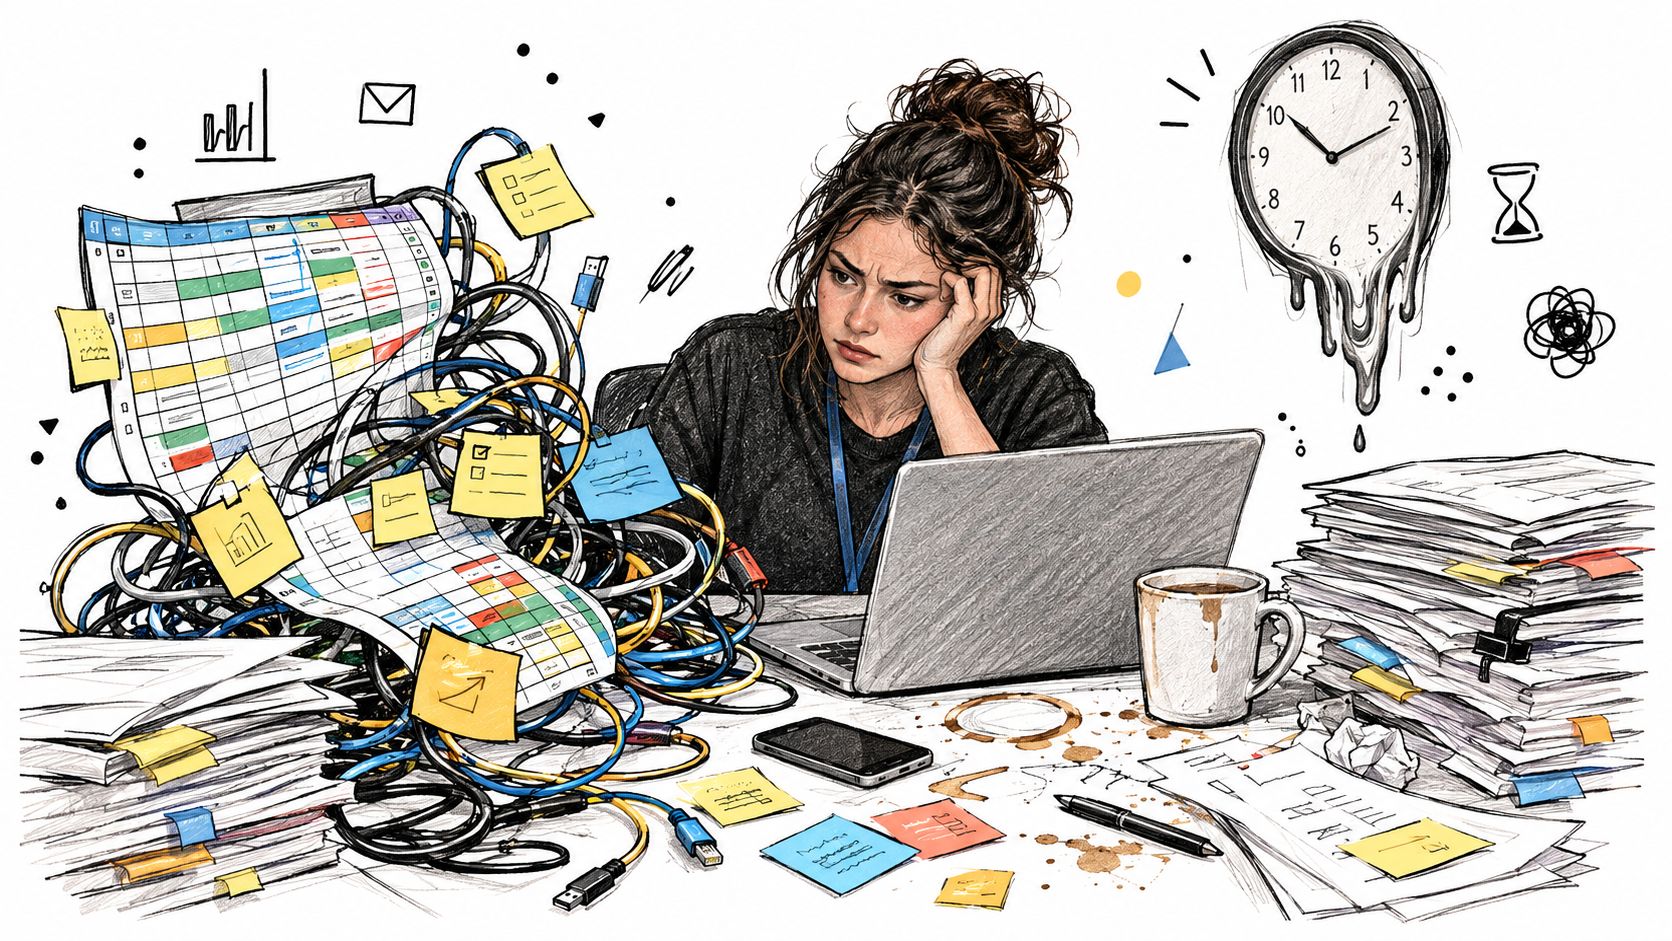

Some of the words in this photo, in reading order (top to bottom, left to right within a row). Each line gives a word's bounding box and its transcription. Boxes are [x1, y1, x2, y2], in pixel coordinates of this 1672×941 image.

[1321, 59, 1341, 81] 12
[1362, 68, 1369, 90] 1
[1290, 72, 1305, 93] 11
[1266, 104, 1285, 126] 10
[1388, 100, 1400, 122] 2
[1258, 146, 1270, 168] 9
[1401, 145, 1413, 167] 3
[1268, 188, 1280, 210] 8
[1390, 190, 1404, 214] 4
[1294, 220, 1305, 241] 7
[1367, 223, 1379, 246] 5
[1329, 234, 1341, 257] 6
